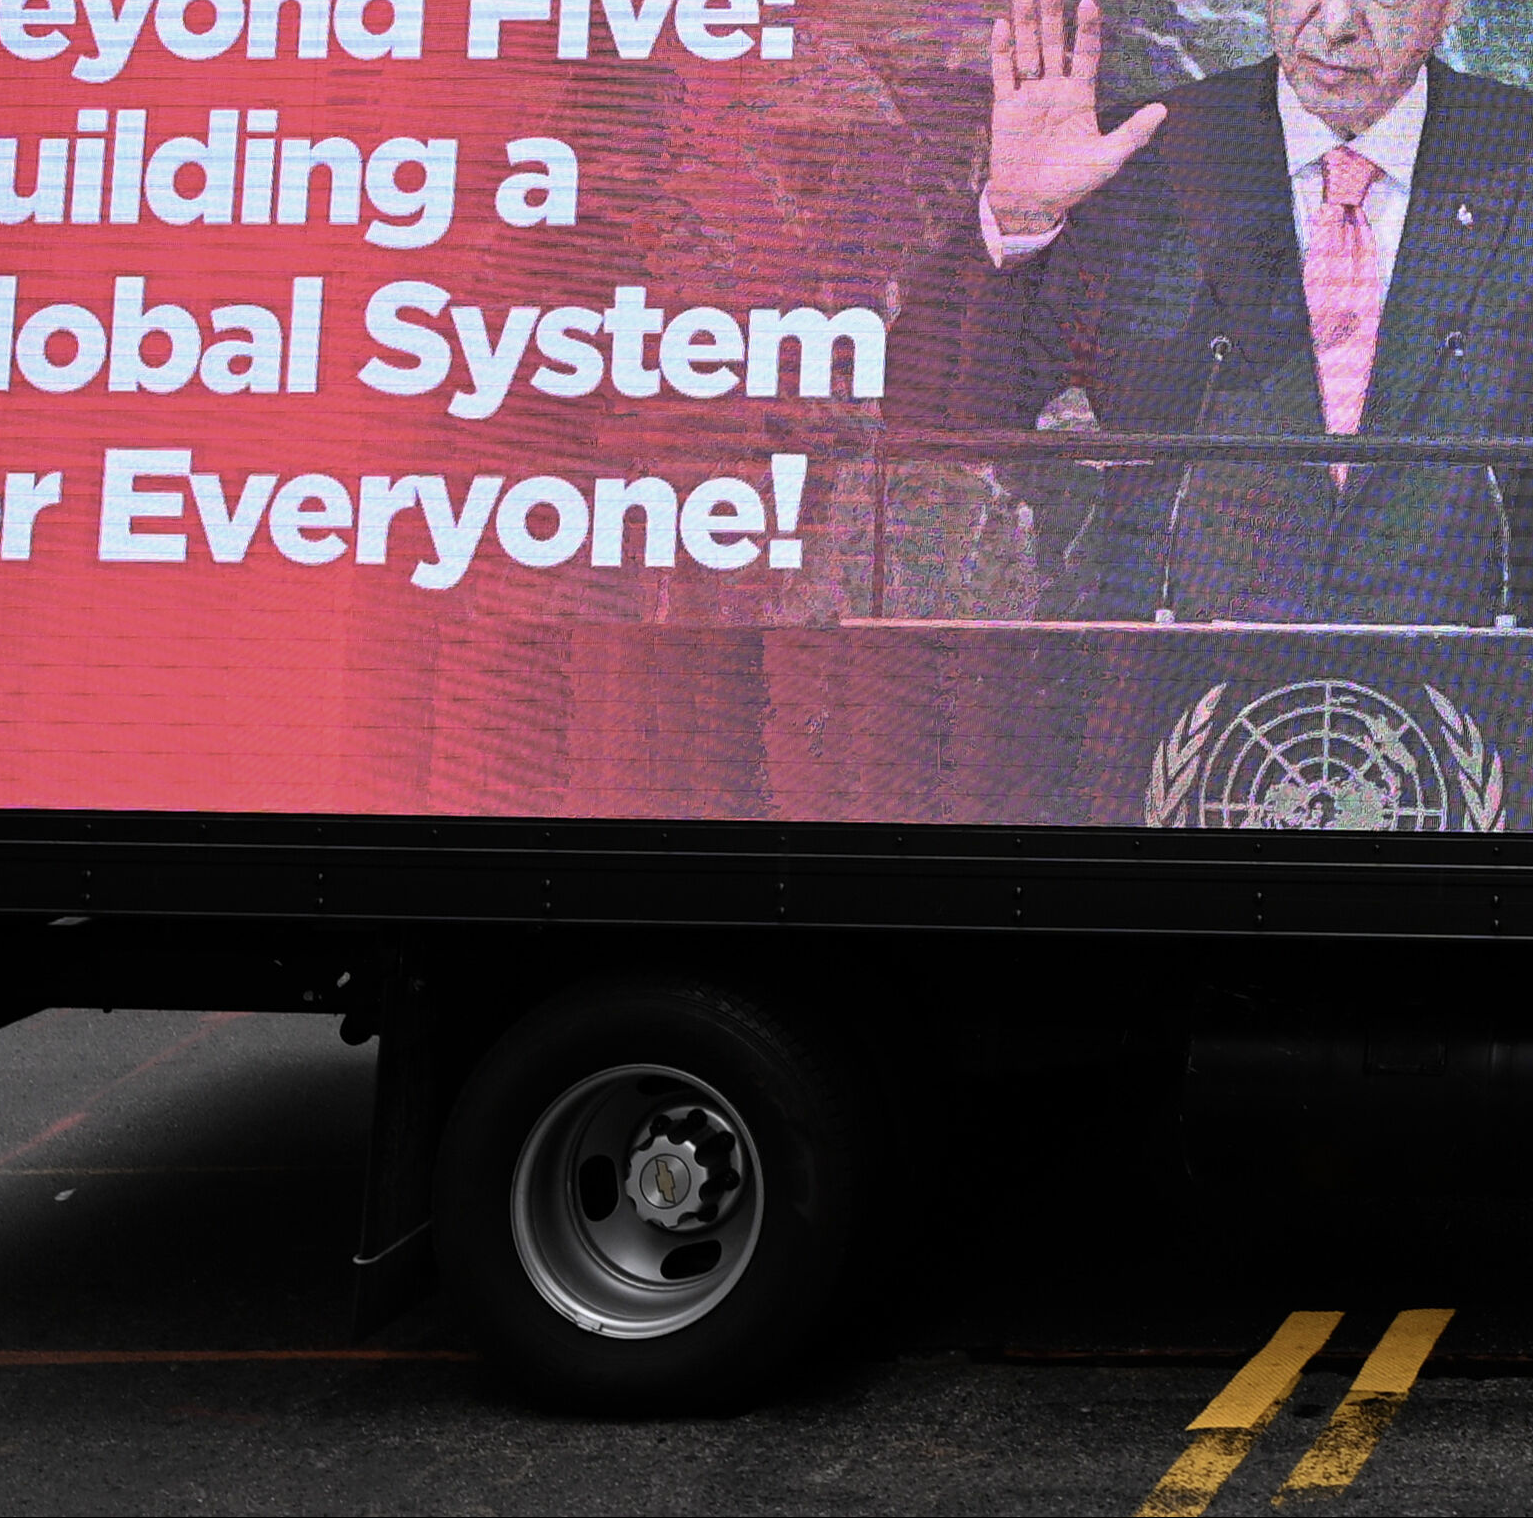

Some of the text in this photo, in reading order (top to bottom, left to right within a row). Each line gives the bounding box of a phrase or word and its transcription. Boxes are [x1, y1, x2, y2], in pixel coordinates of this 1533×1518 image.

[495, 136, 580, 227] a
[358, 280, 888, 419] System
[97, 448, 809, 590] Everyone!
